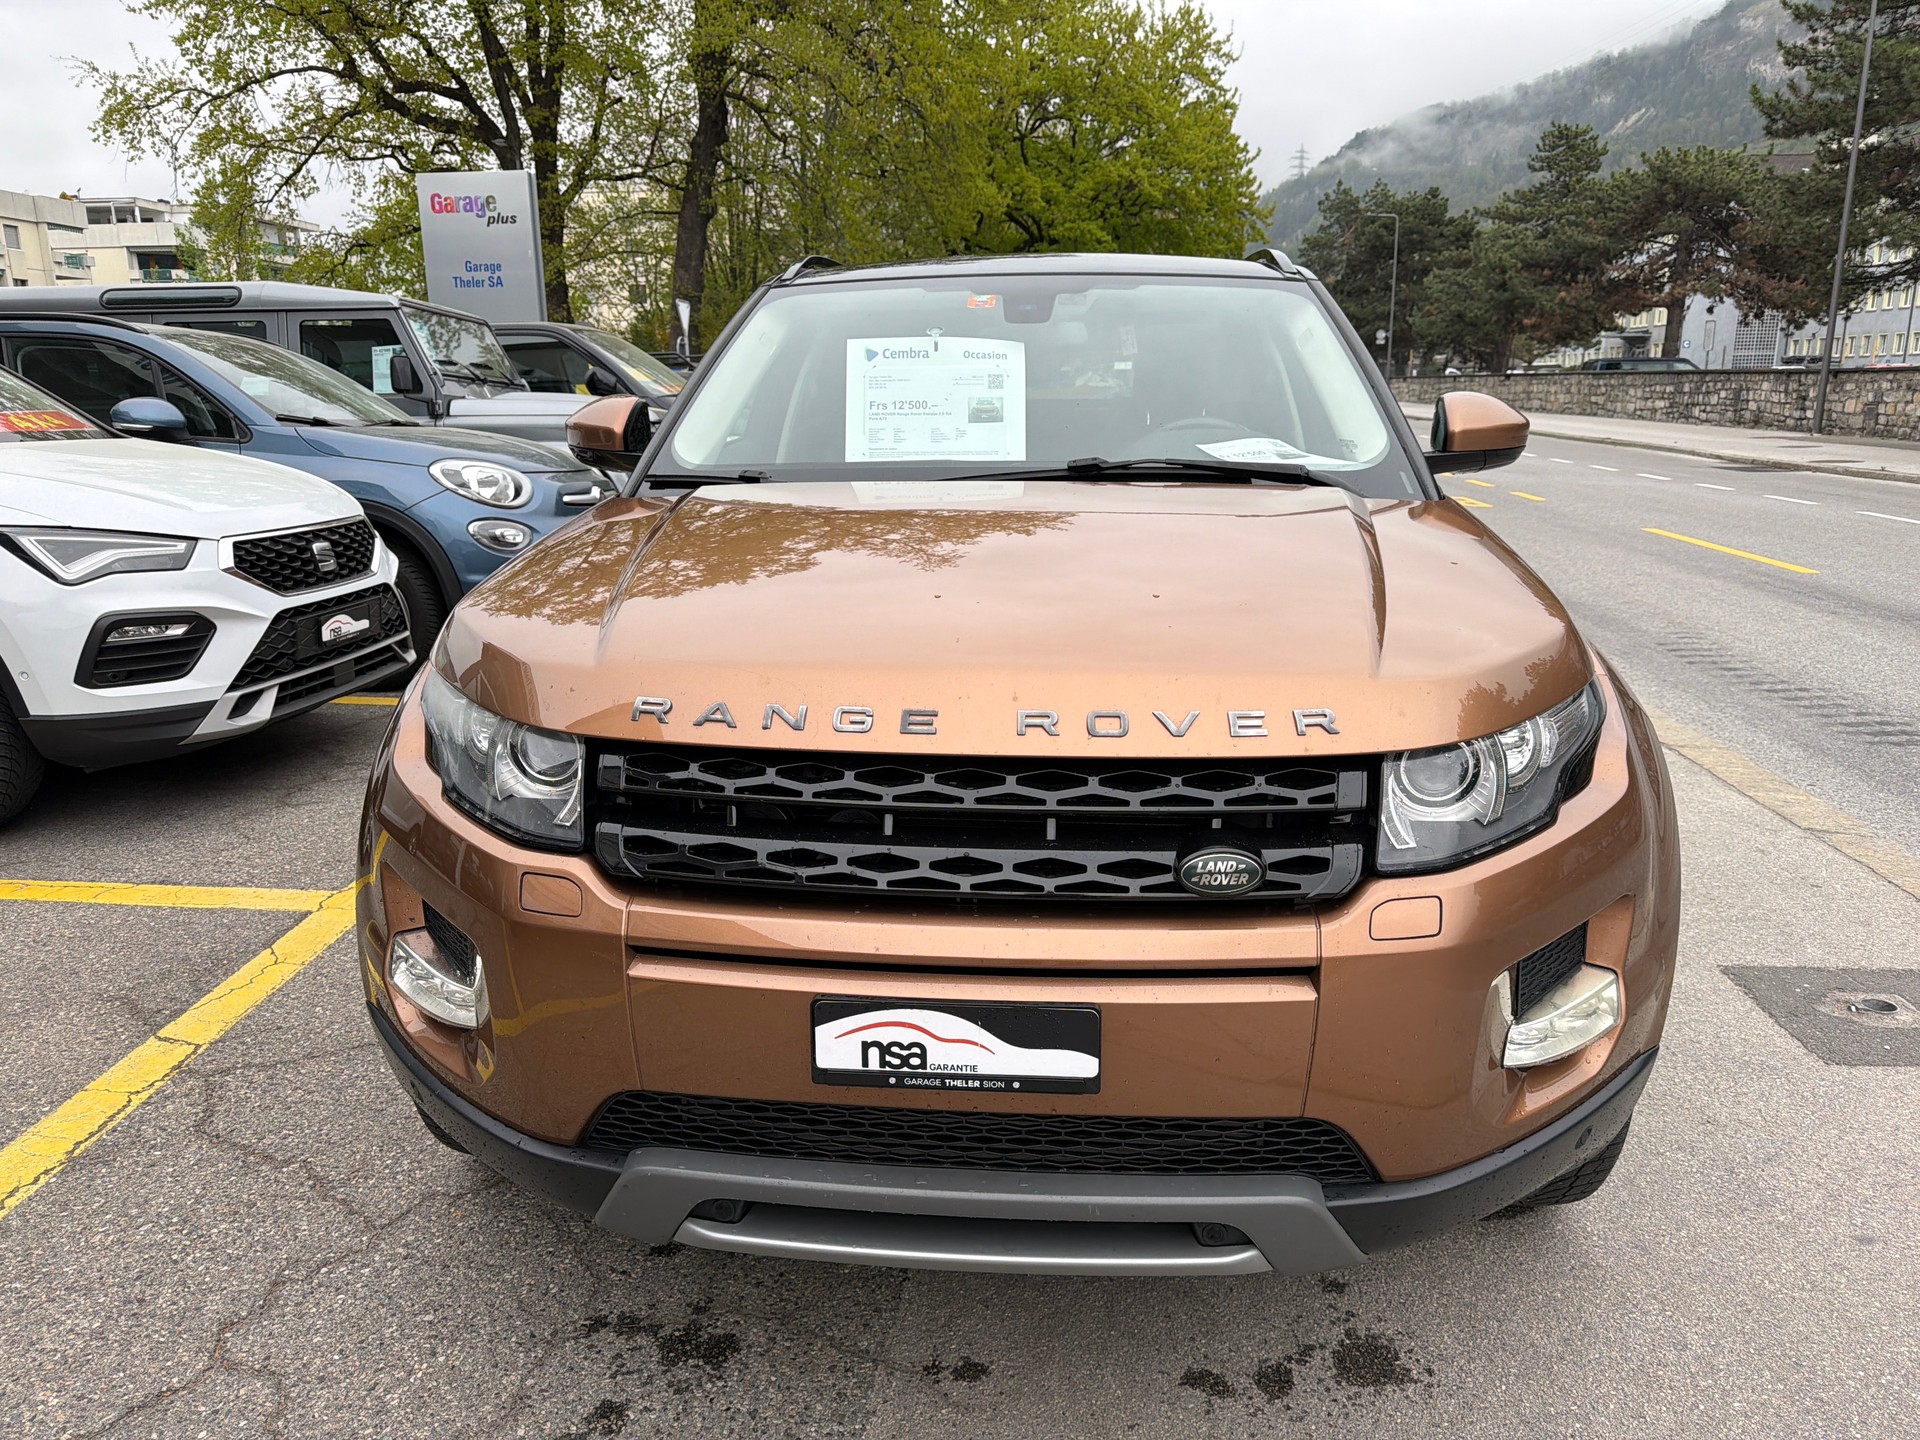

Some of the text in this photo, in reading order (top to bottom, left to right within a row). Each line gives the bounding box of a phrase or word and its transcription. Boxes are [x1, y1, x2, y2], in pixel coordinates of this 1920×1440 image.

[430, 192, 497, 219] Garage
[486, 212, 517, 227] plus
[464, 260, 502, 275] Garage
[452, 275, 504, 289] Theler SA
[882, 347, 930, 359] Cembra
[869, 400, 888, 411] Frs
[330, 626, 342, 639] nsa
[630, 695, 1341, 738] RANGE ROVER
[1196, 861, 1236, 873] LAND
[1199, 874, 1249, 885] ROVER
[861, 1040, 979, 1073] nsa GARANTIE
[903, 1077, 1006, 1089] GARAGE THELER SION
